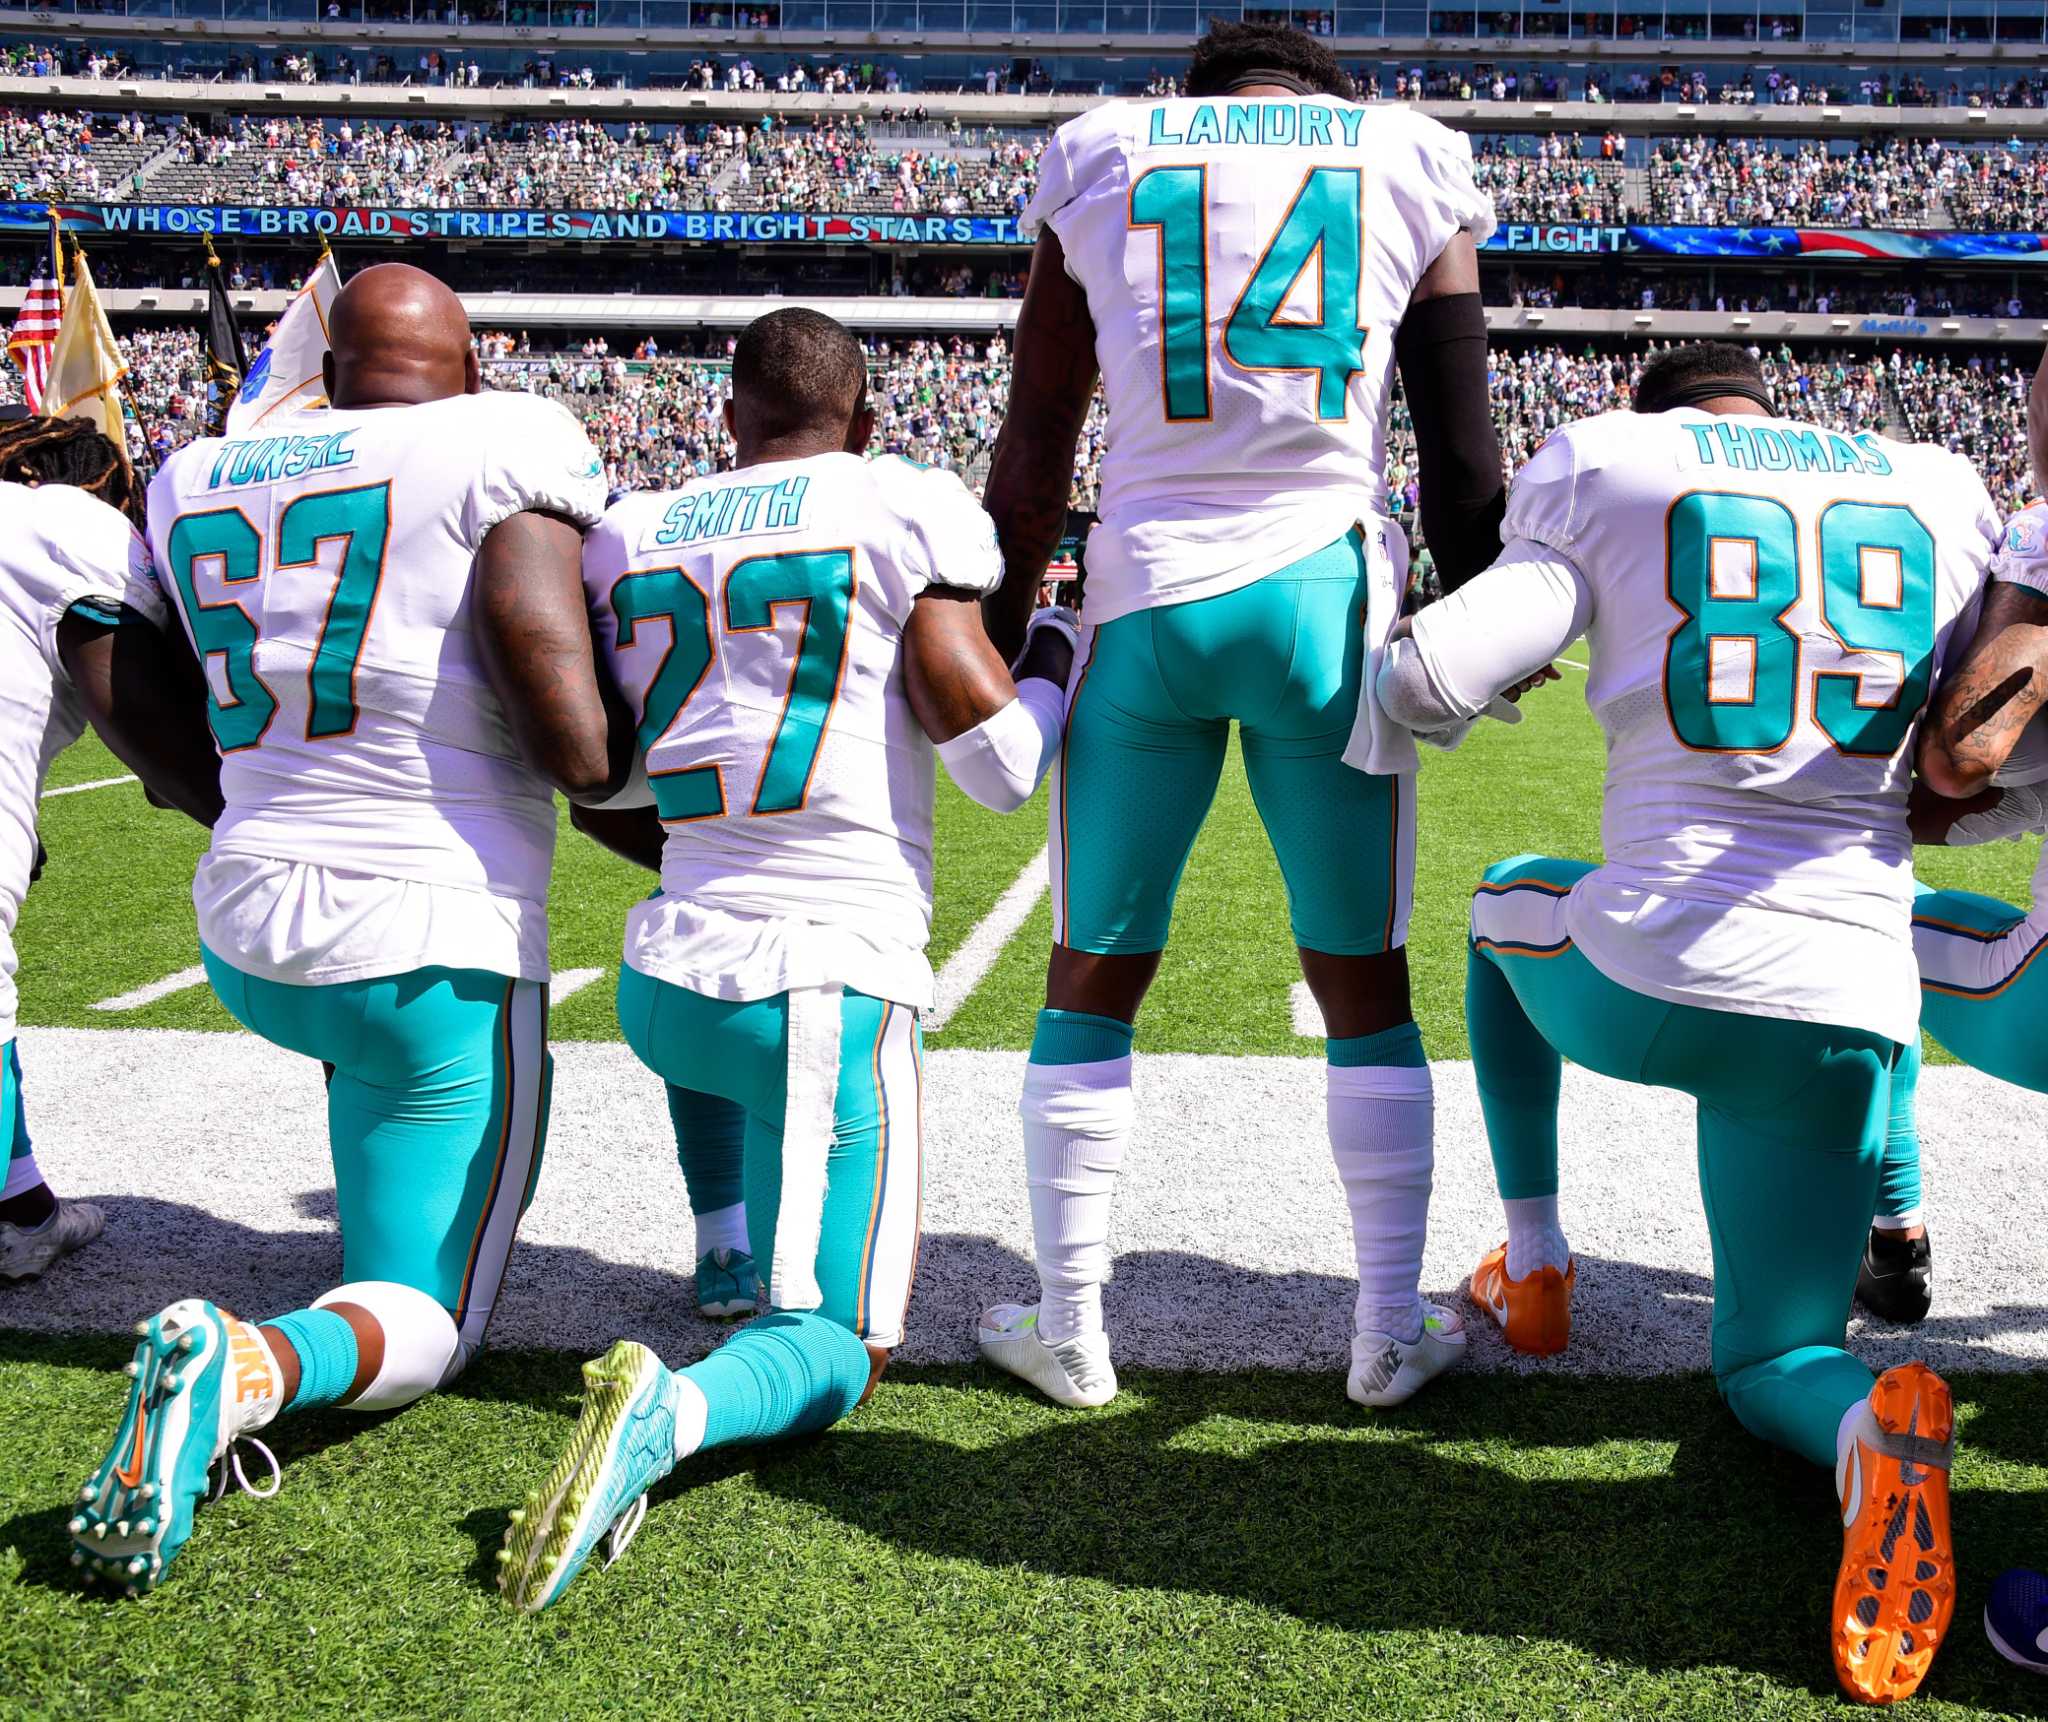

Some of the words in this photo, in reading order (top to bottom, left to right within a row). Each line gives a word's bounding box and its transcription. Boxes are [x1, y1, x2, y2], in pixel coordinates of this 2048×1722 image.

[1150, 104, 1366, 147] LANDRY
[101, 207, 242, 232] WHOSE
[260, 210, 392, 236] BROAD
[409, 212, 573, 237] STRIPES
[588, 214, 667, 239] AND
[686, 215, 832, 241] BRIGHT
[849, 216, 973, 242] STARS
[1507, 226, 1626, 251] FIGHT
[1128, 162, 1369, 423] 14
[208, 426, 362, 489] TUNSIL
[1680, 422, 1893, 476] THOMAS
[656, 476, 809, 544] SMITH
[168, 478, 393, 755] 67
[1662, 488, 1936, 757] 89
[610, 547, 856, 825] 27
